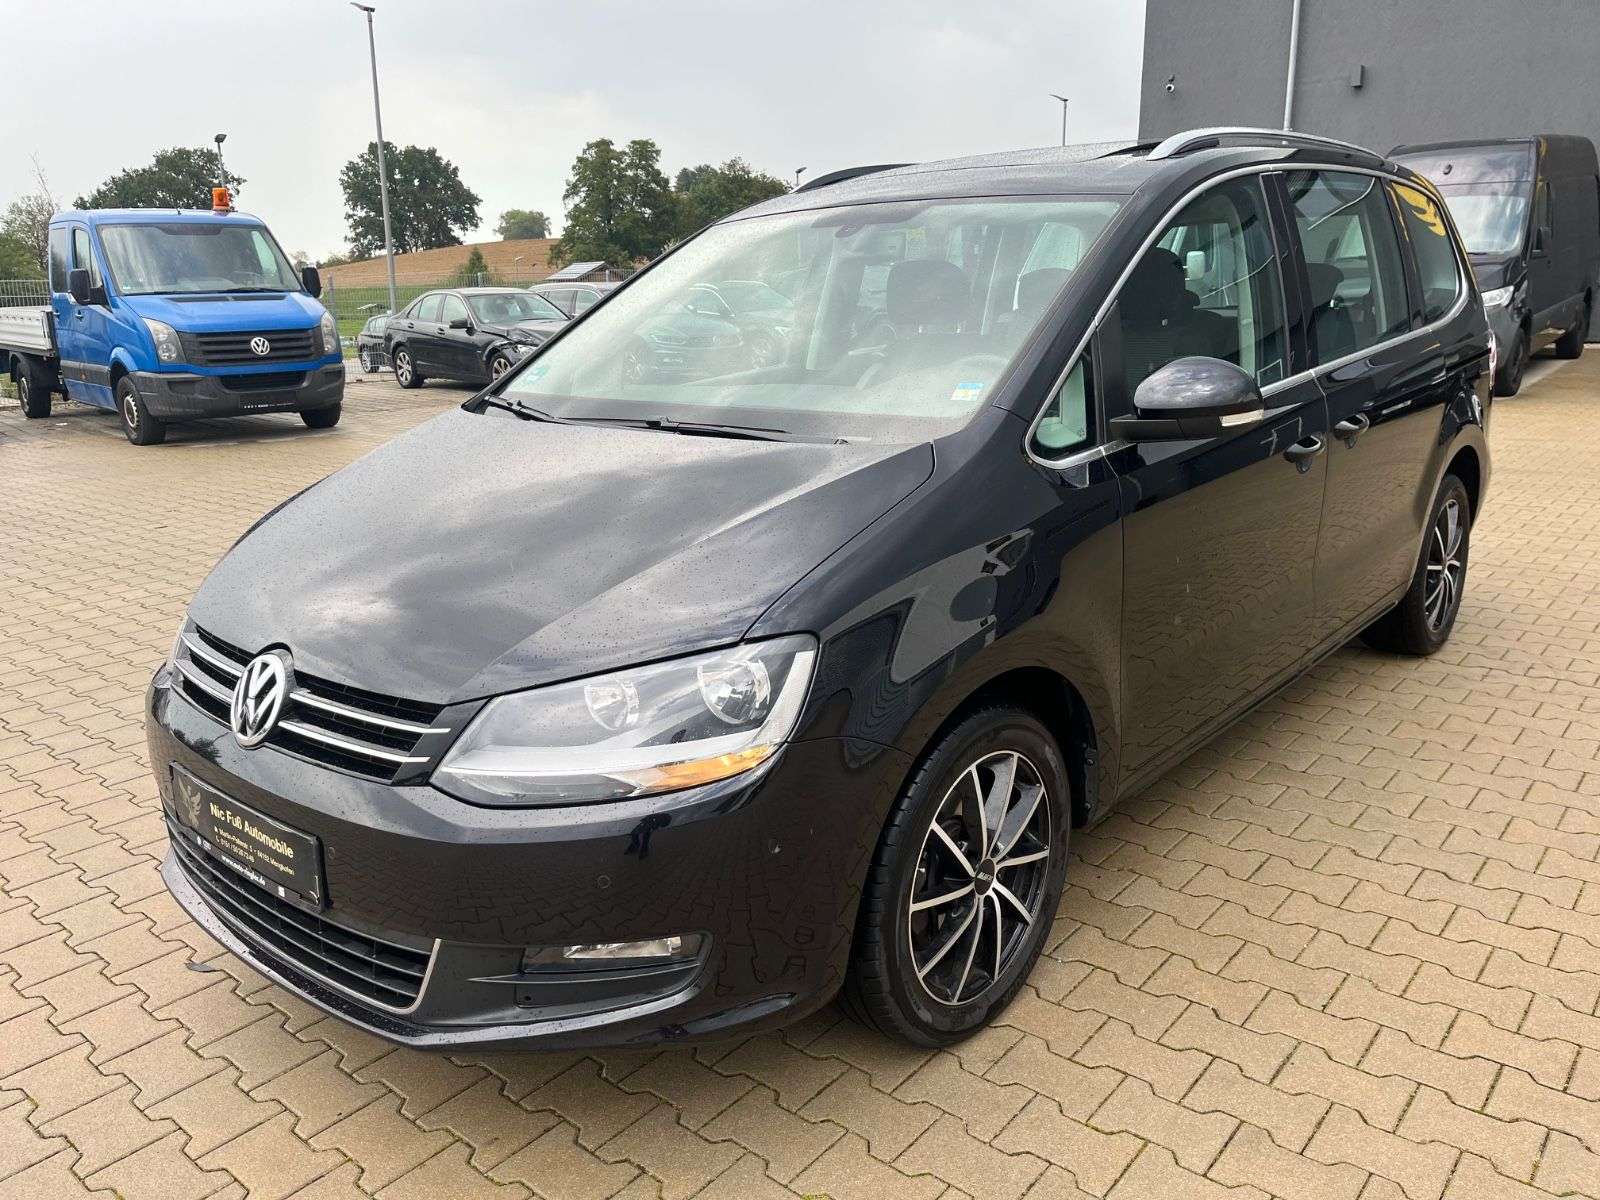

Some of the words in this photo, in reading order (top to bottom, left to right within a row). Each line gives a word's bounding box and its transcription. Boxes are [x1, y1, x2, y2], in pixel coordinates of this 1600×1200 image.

[209, 802, 225, 820] Nic
[226, 810, 243, 830] Fuß
[244, 820, 294, 858] Automobile
